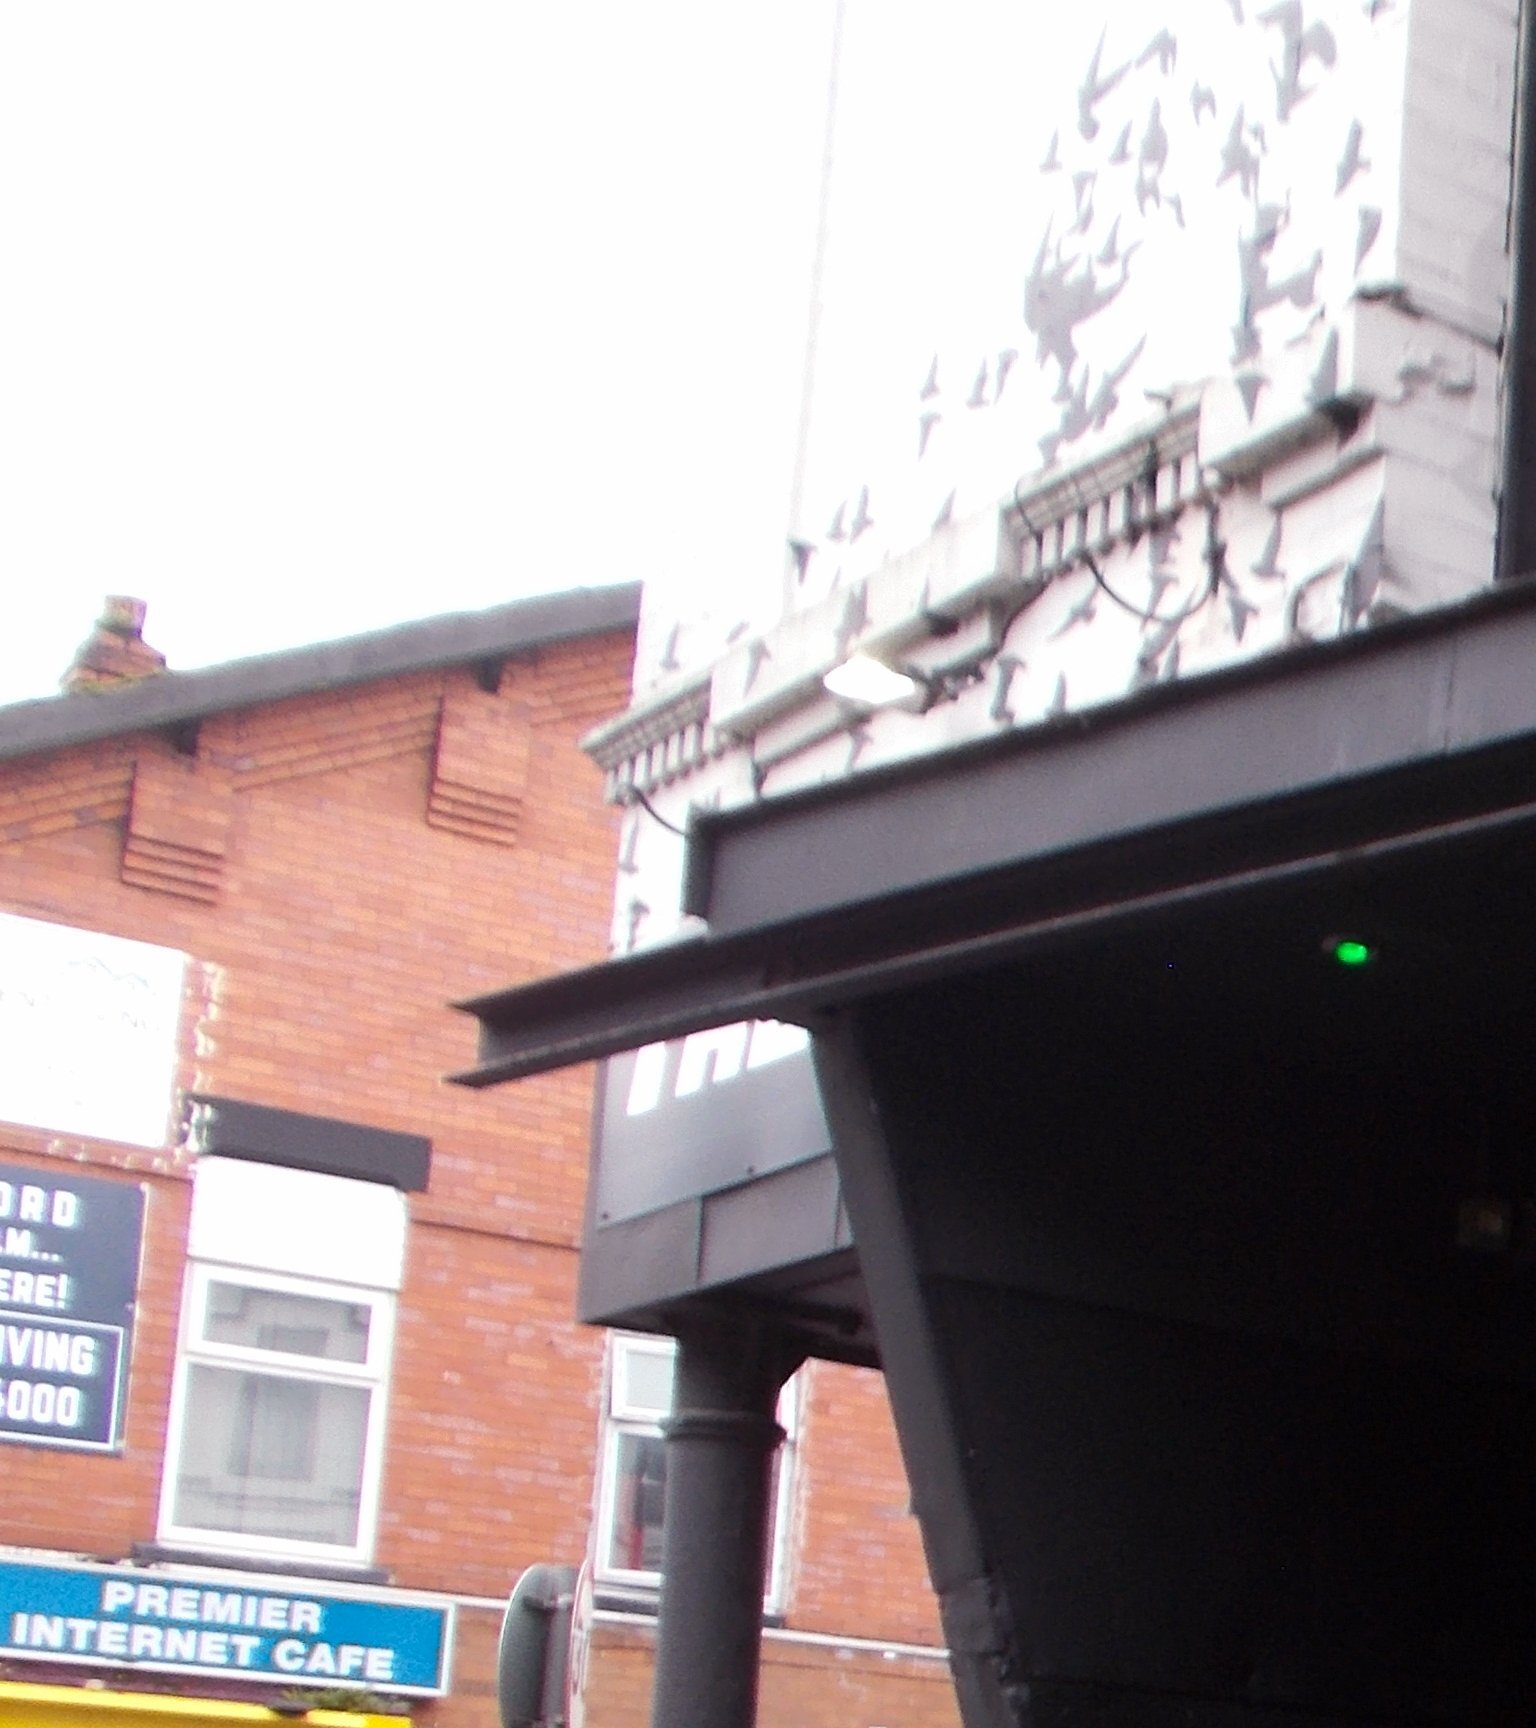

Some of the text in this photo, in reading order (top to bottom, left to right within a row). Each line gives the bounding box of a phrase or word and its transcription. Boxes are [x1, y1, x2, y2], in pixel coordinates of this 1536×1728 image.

[0, 1378, 81, 1427] 000
[103, 1580, 321, 1634] PREMIER
[12, 1612, 395, 1681] INTERNET CAFE
